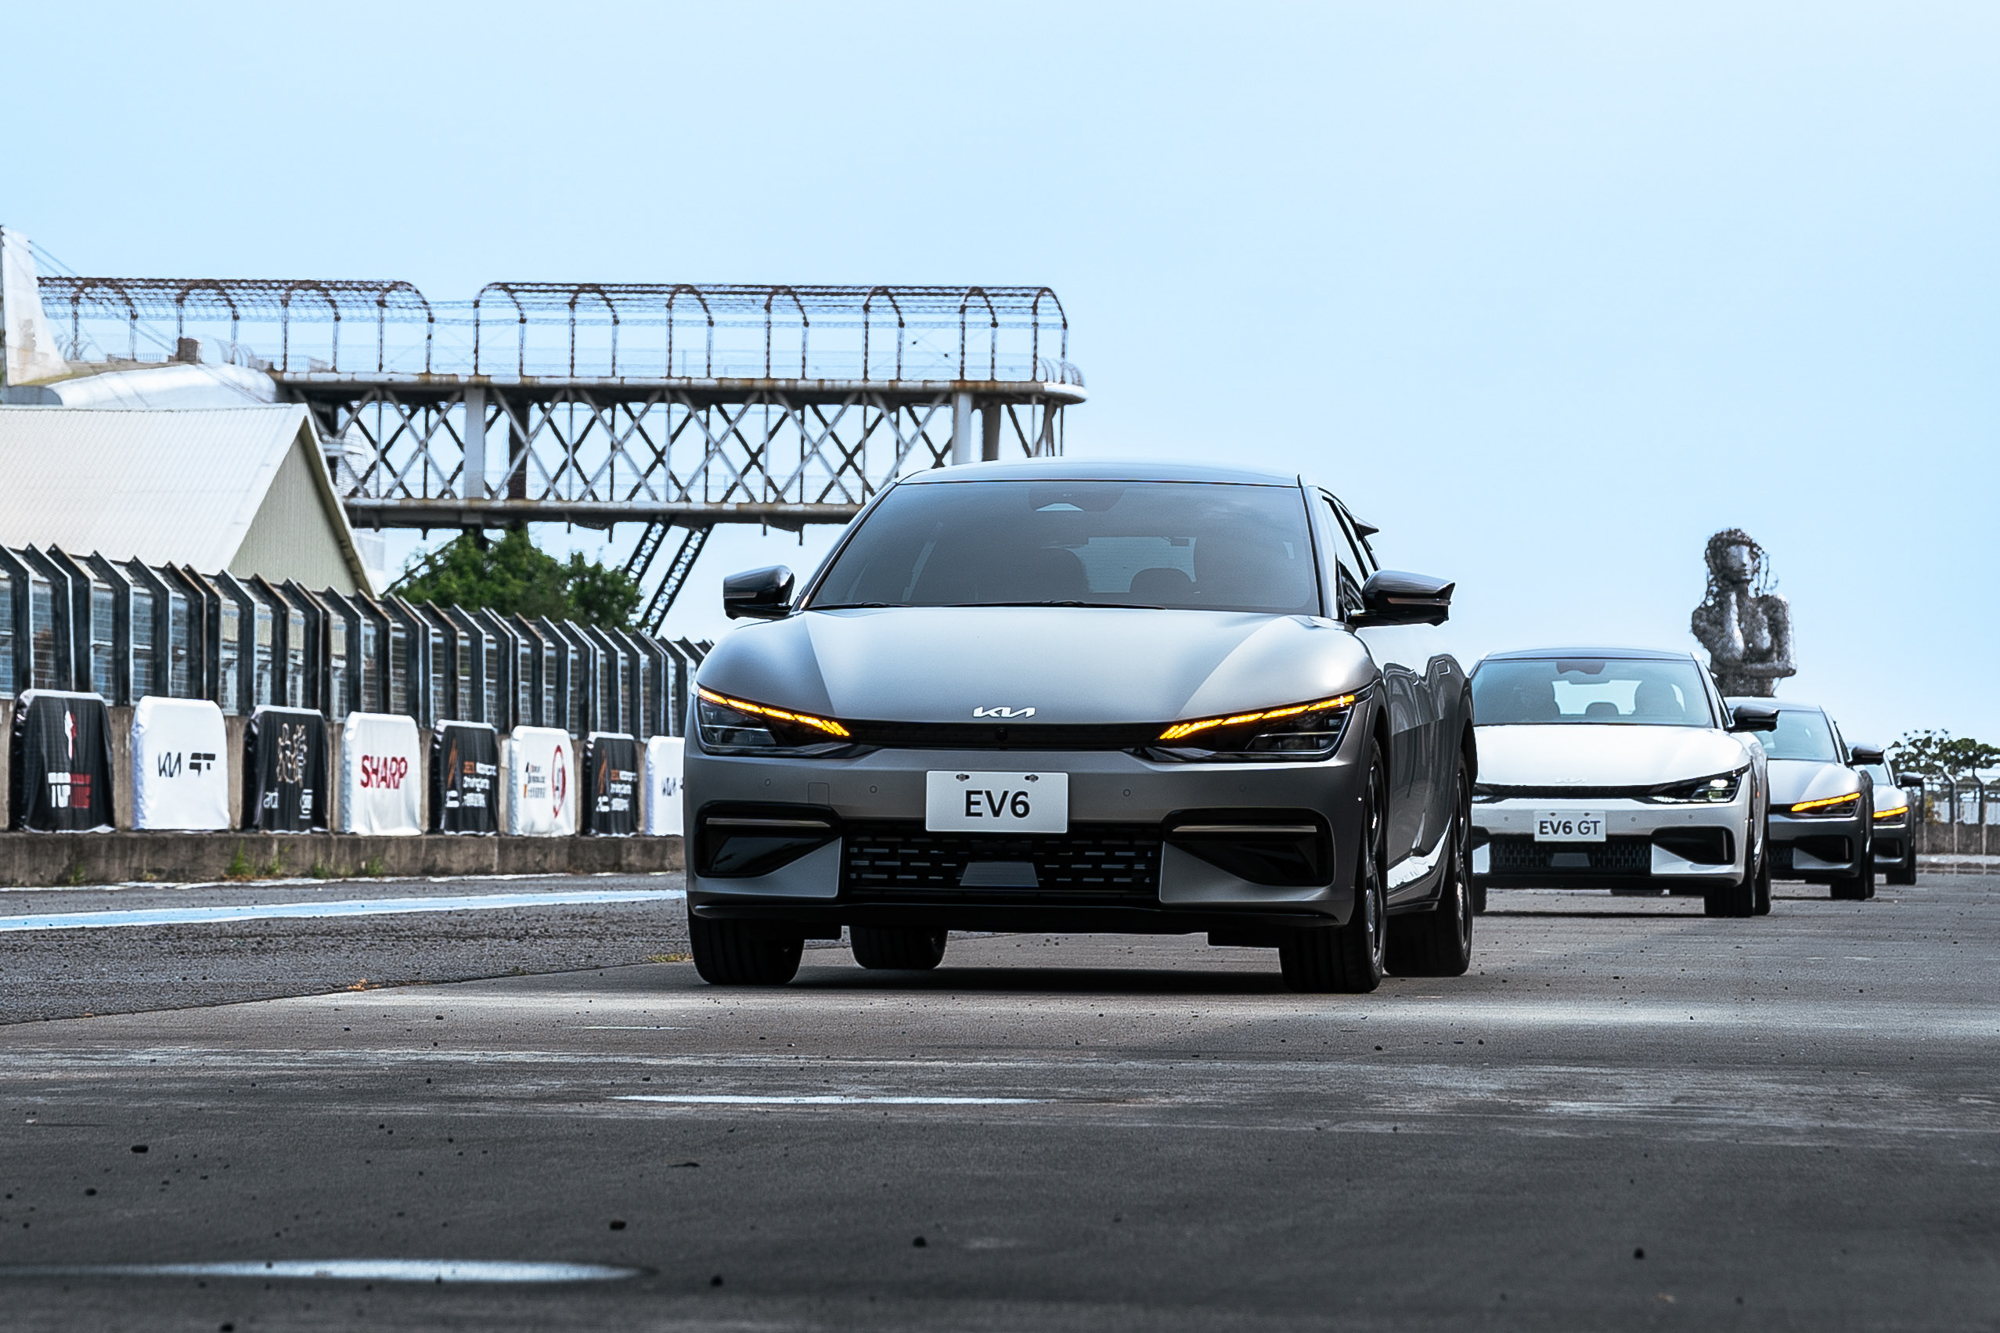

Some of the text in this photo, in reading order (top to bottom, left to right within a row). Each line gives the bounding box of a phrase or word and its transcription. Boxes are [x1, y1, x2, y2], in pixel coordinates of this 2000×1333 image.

[360, 754, 408, 790] SHARP
[965, 790, 1030, 818] EV6
[1539, 820, 1601, 836] EV6 GT
